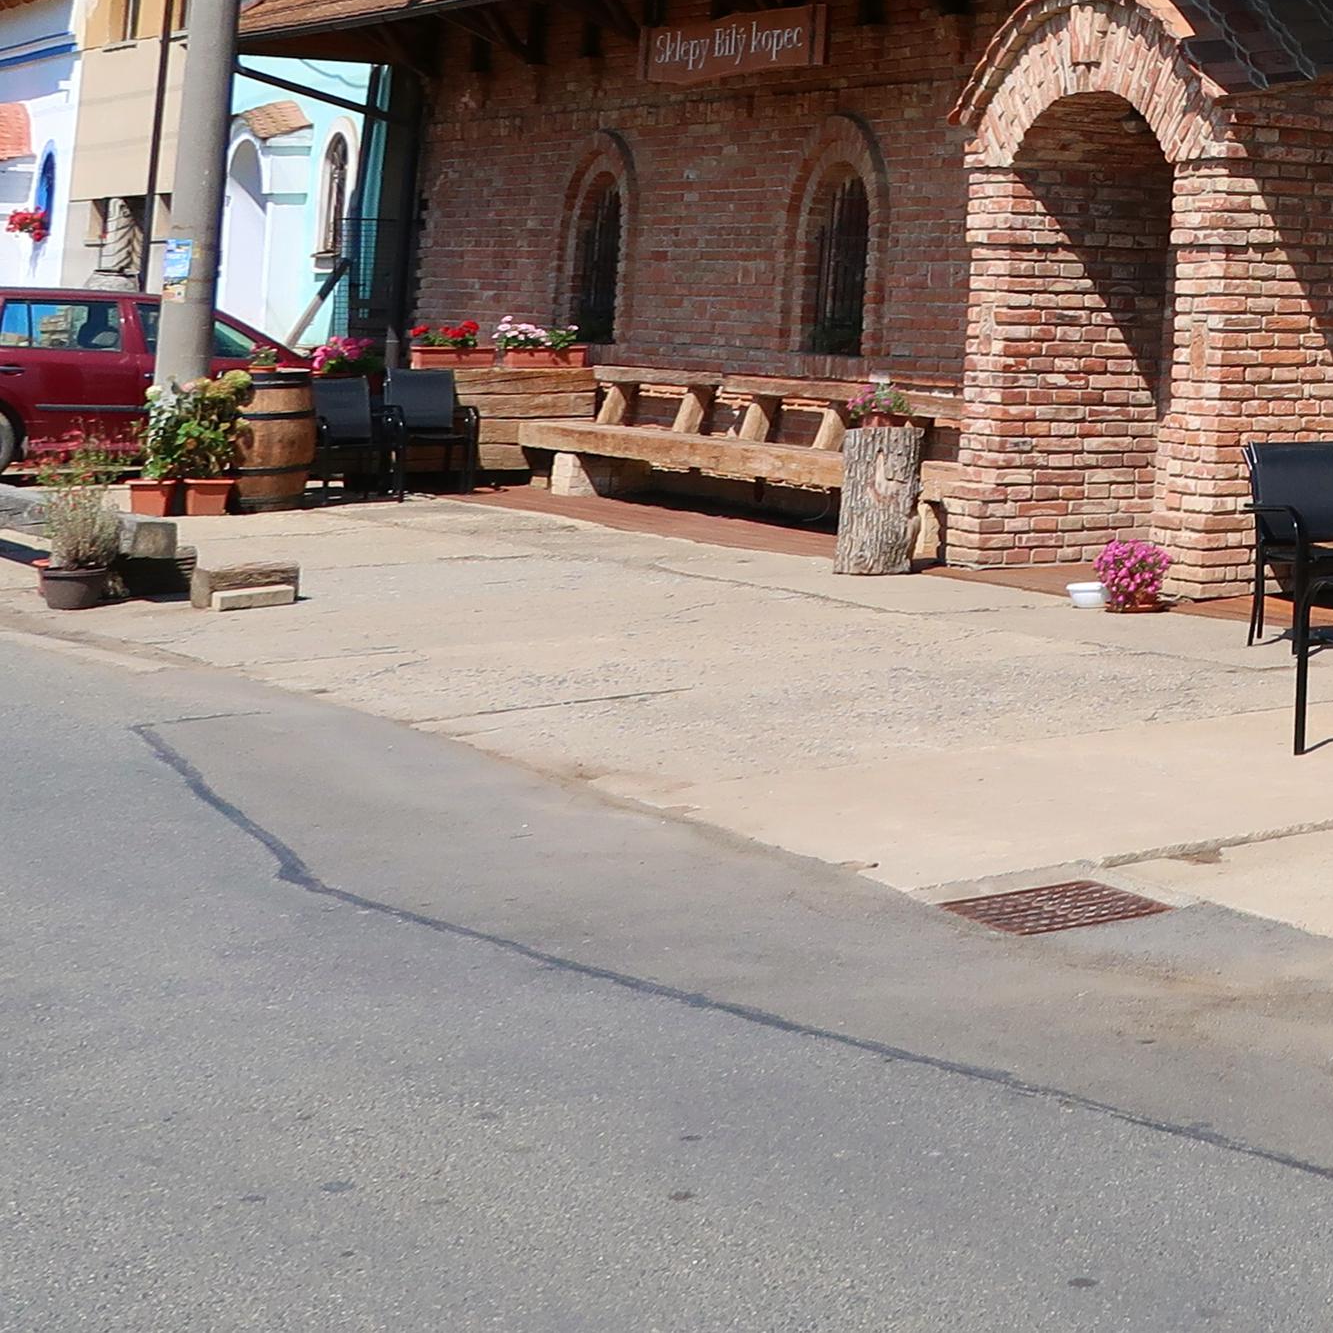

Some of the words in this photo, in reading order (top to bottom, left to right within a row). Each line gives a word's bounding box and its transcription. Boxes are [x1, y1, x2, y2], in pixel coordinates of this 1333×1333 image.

[655, 31, 710, 70] Sklepy
[713, 23, 746, 66] Bílý
[750, 21, 804, 62] kopec
